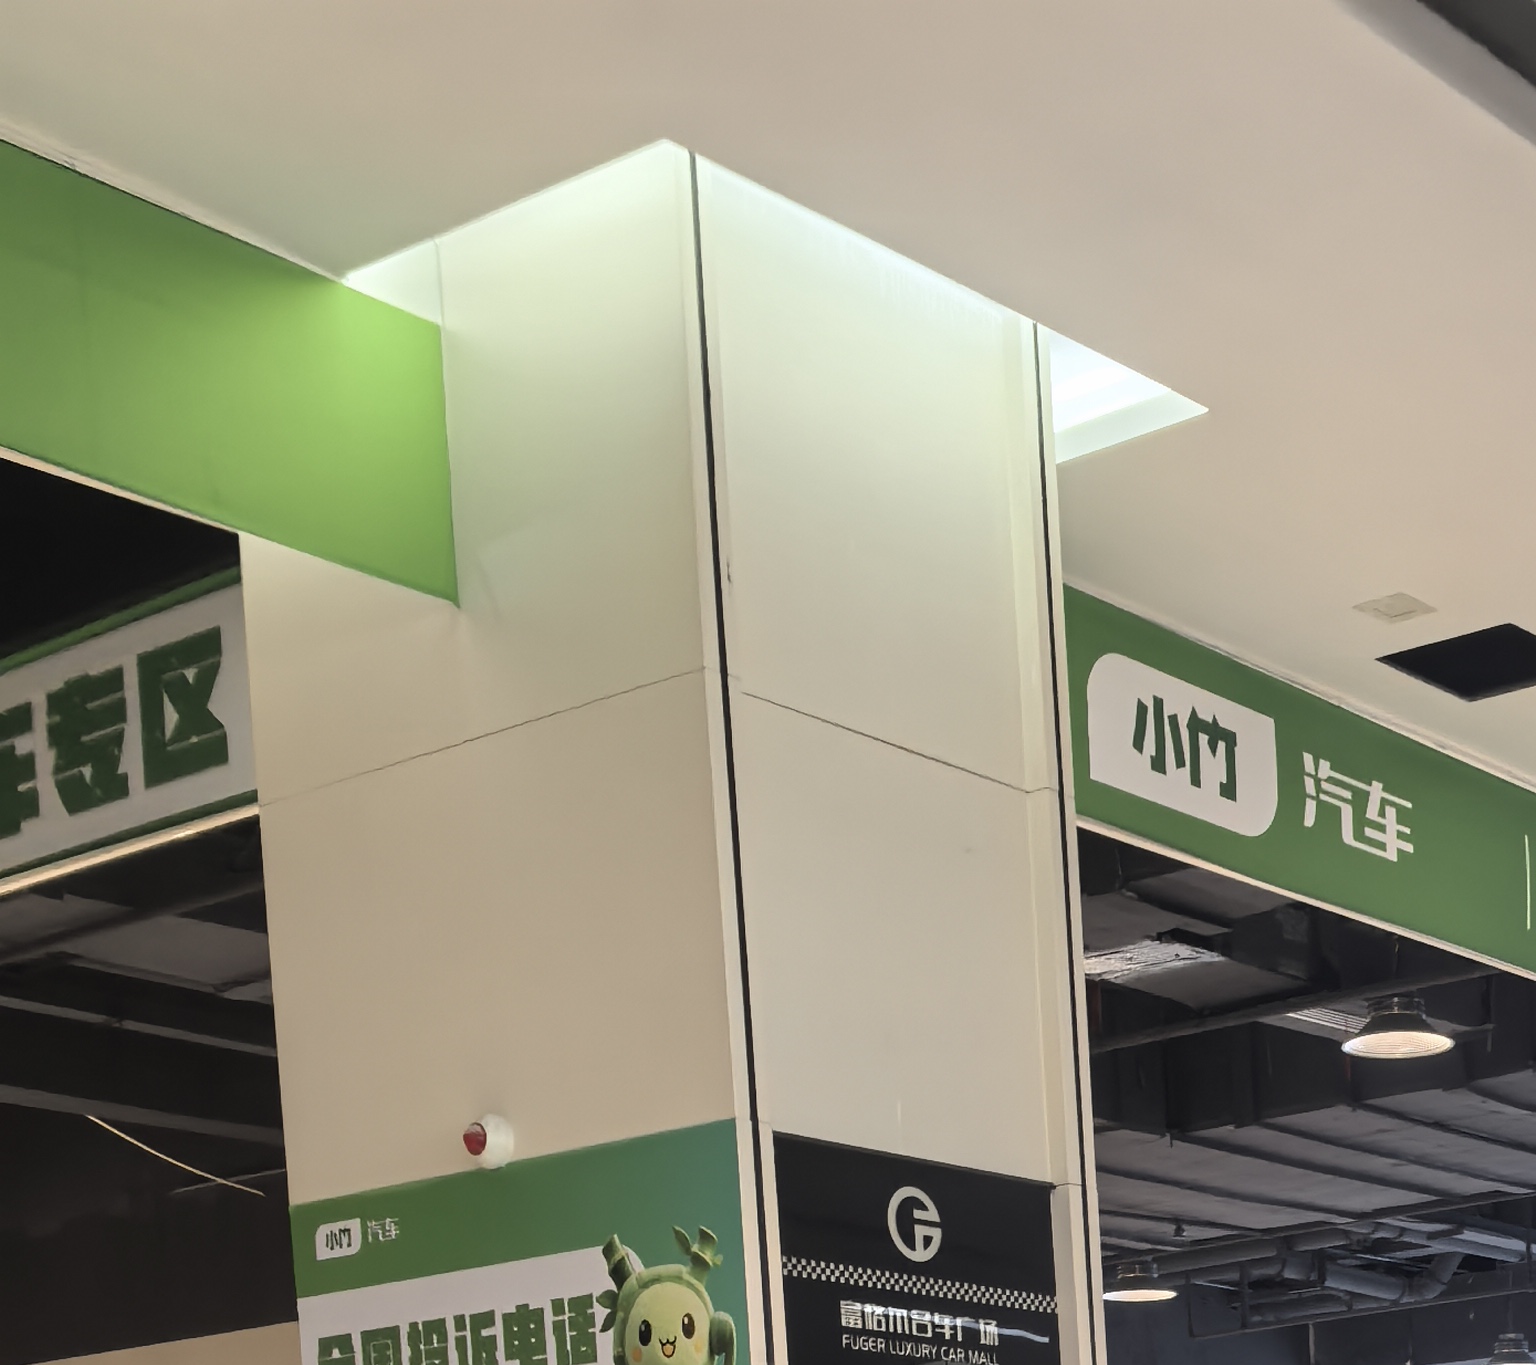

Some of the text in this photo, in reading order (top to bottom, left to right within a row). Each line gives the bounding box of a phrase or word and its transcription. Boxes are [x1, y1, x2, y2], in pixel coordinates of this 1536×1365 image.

[1132, 695, 1414, 862] 小竹 汽车
[366, 1217, 400, 1243] 汽车
[842, 1334, 886, 1353] FUGER
[889, 1340, 938, 1360] LUXURY
[941, 1346, 965, 1363] CAR
